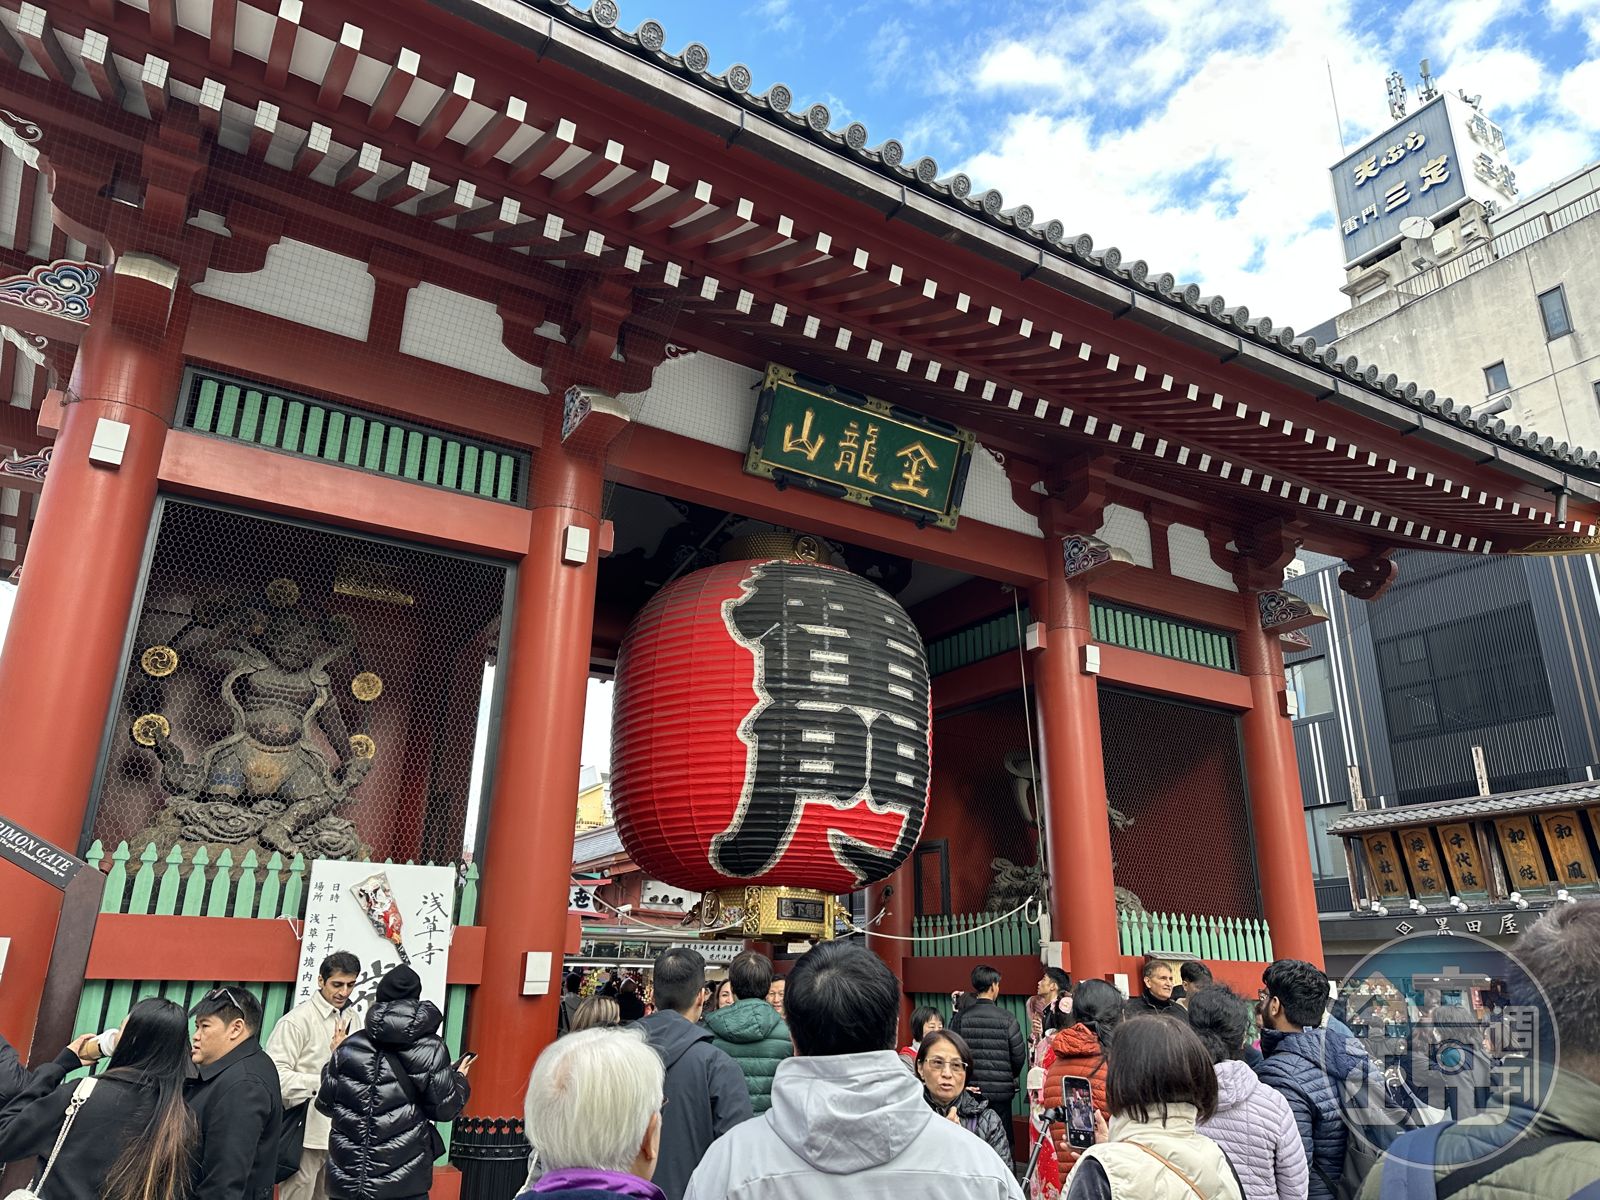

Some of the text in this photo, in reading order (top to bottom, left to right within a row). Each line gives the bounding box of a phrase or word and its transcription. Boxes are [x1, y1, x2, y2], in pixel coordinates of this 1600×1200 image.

[1353, 131, 1427, 187] 天ぷら
[1341, 154, 1451, 236] 雷門 三定
[36, 847, 74, 871] GATE
[329, 882, 341, 904] 日時
[298, 881, 325, 1005] 場所 浅草寺境内五
[410, 891, 449, 966] 浅草寺
